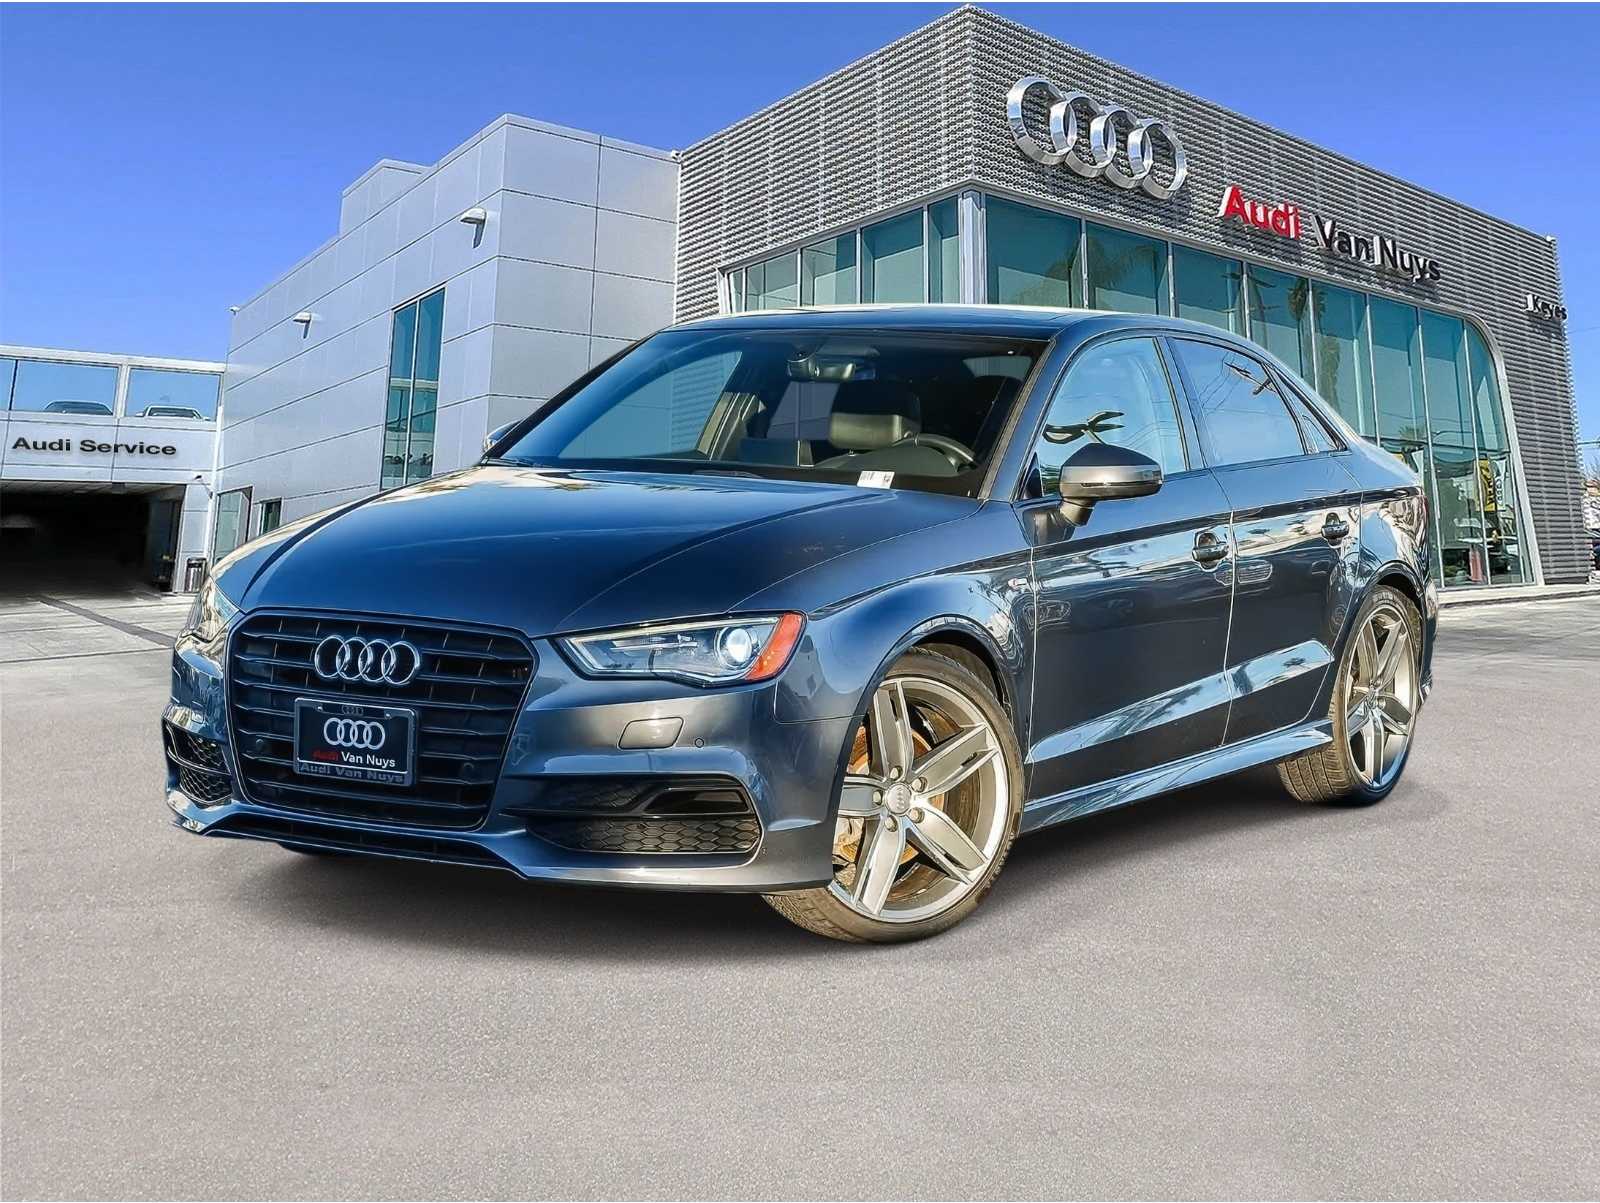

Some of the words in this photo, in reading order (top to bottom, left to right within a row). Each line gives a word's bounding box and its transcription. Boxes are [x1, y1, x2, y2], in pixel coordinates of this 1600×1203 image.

[1215, 185, 1301, 240] Audi
[1309, 214, 1372, 261] Van
[1373, 234, 1440, 283] Nuys
[1526, 293, 1568, 320] Keyes
[12, 436, 72, 451] Audi
[79, 439, 177, 456] Service
[341, 751, 363, 764] Van
[366, 754, 396, 769] Nuys
[300, 763, 331, 774] Audi
[335, 766, 362, 778] Van
[367, 770, 404, 783] Nuys
